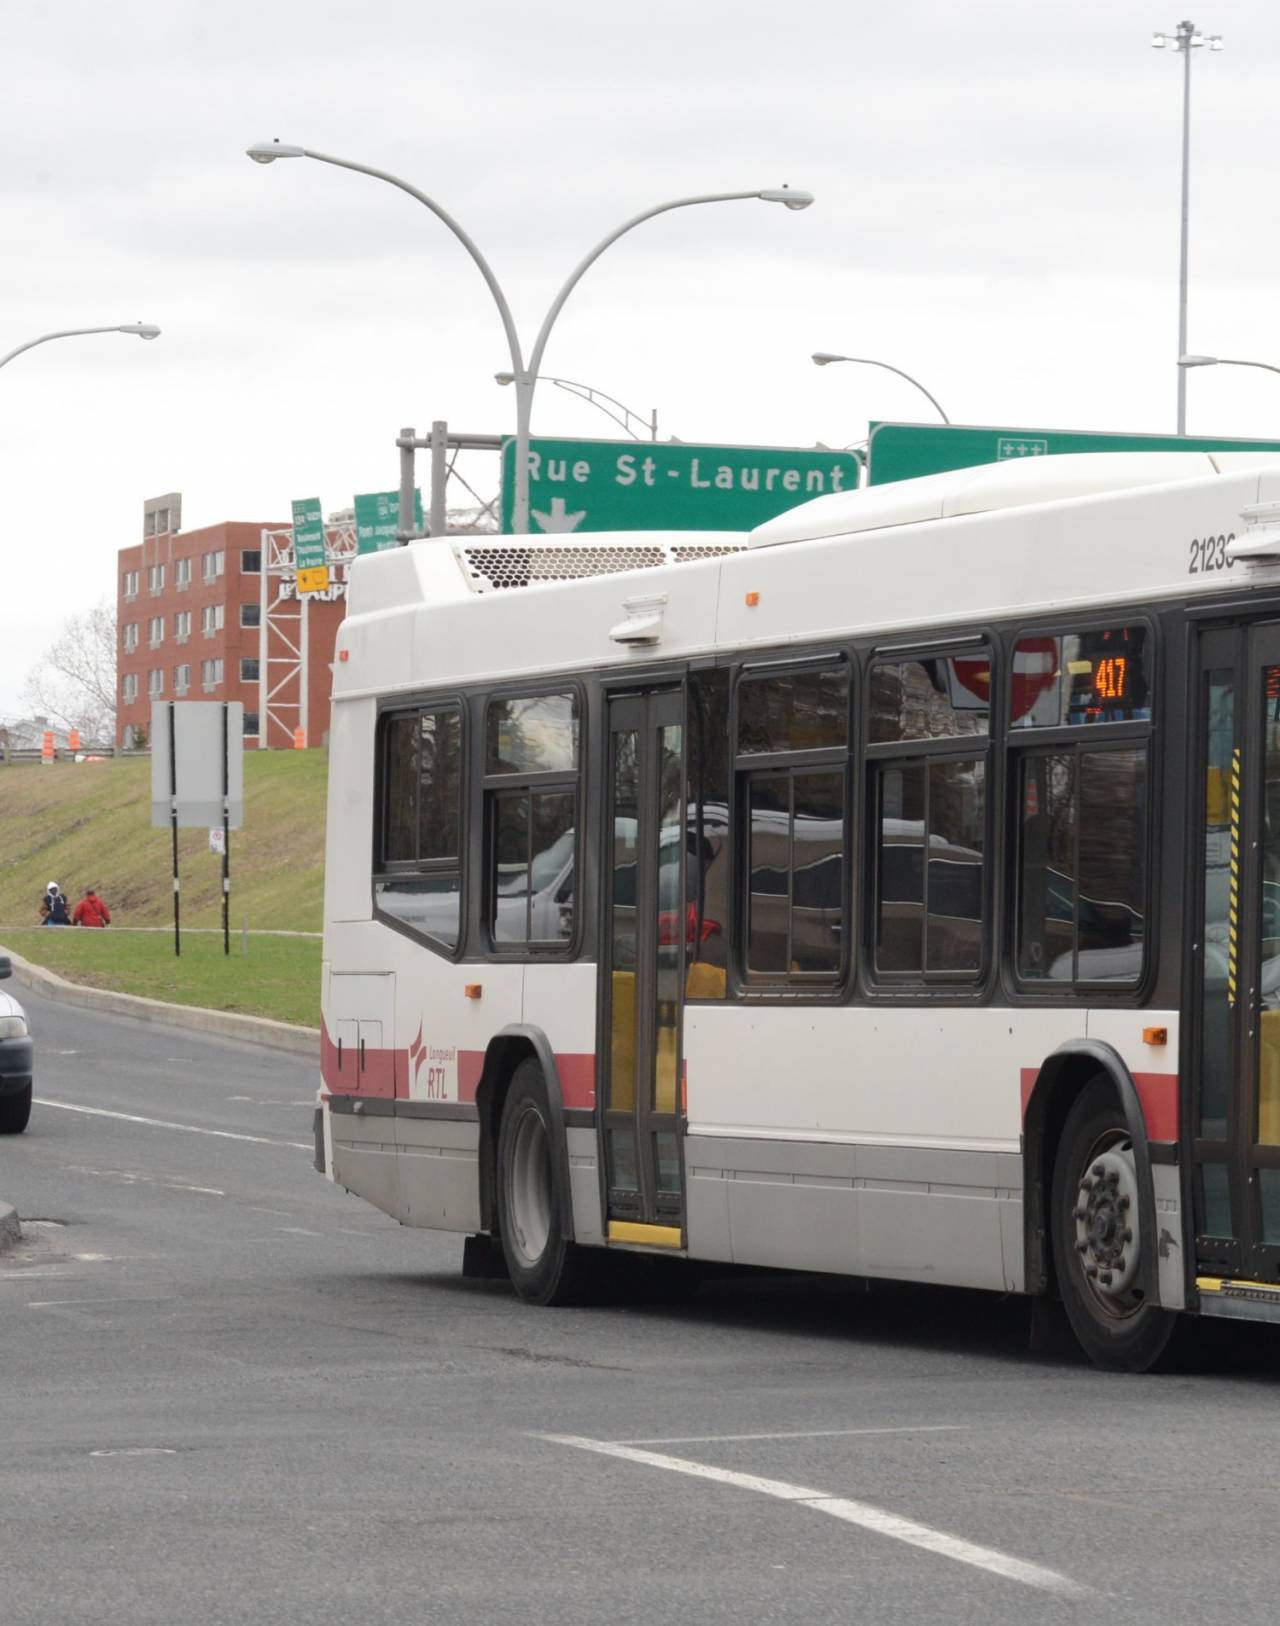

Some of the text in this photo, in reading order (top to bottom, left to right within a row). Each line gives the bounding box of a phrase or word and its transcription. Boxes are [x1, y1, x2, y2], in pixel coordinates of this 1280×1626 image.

[527, 451, 845, 492] Rue St-Laurent
[1096, 658, 1126, 697] 417
[427, 1067, 448, 1099] RTL
